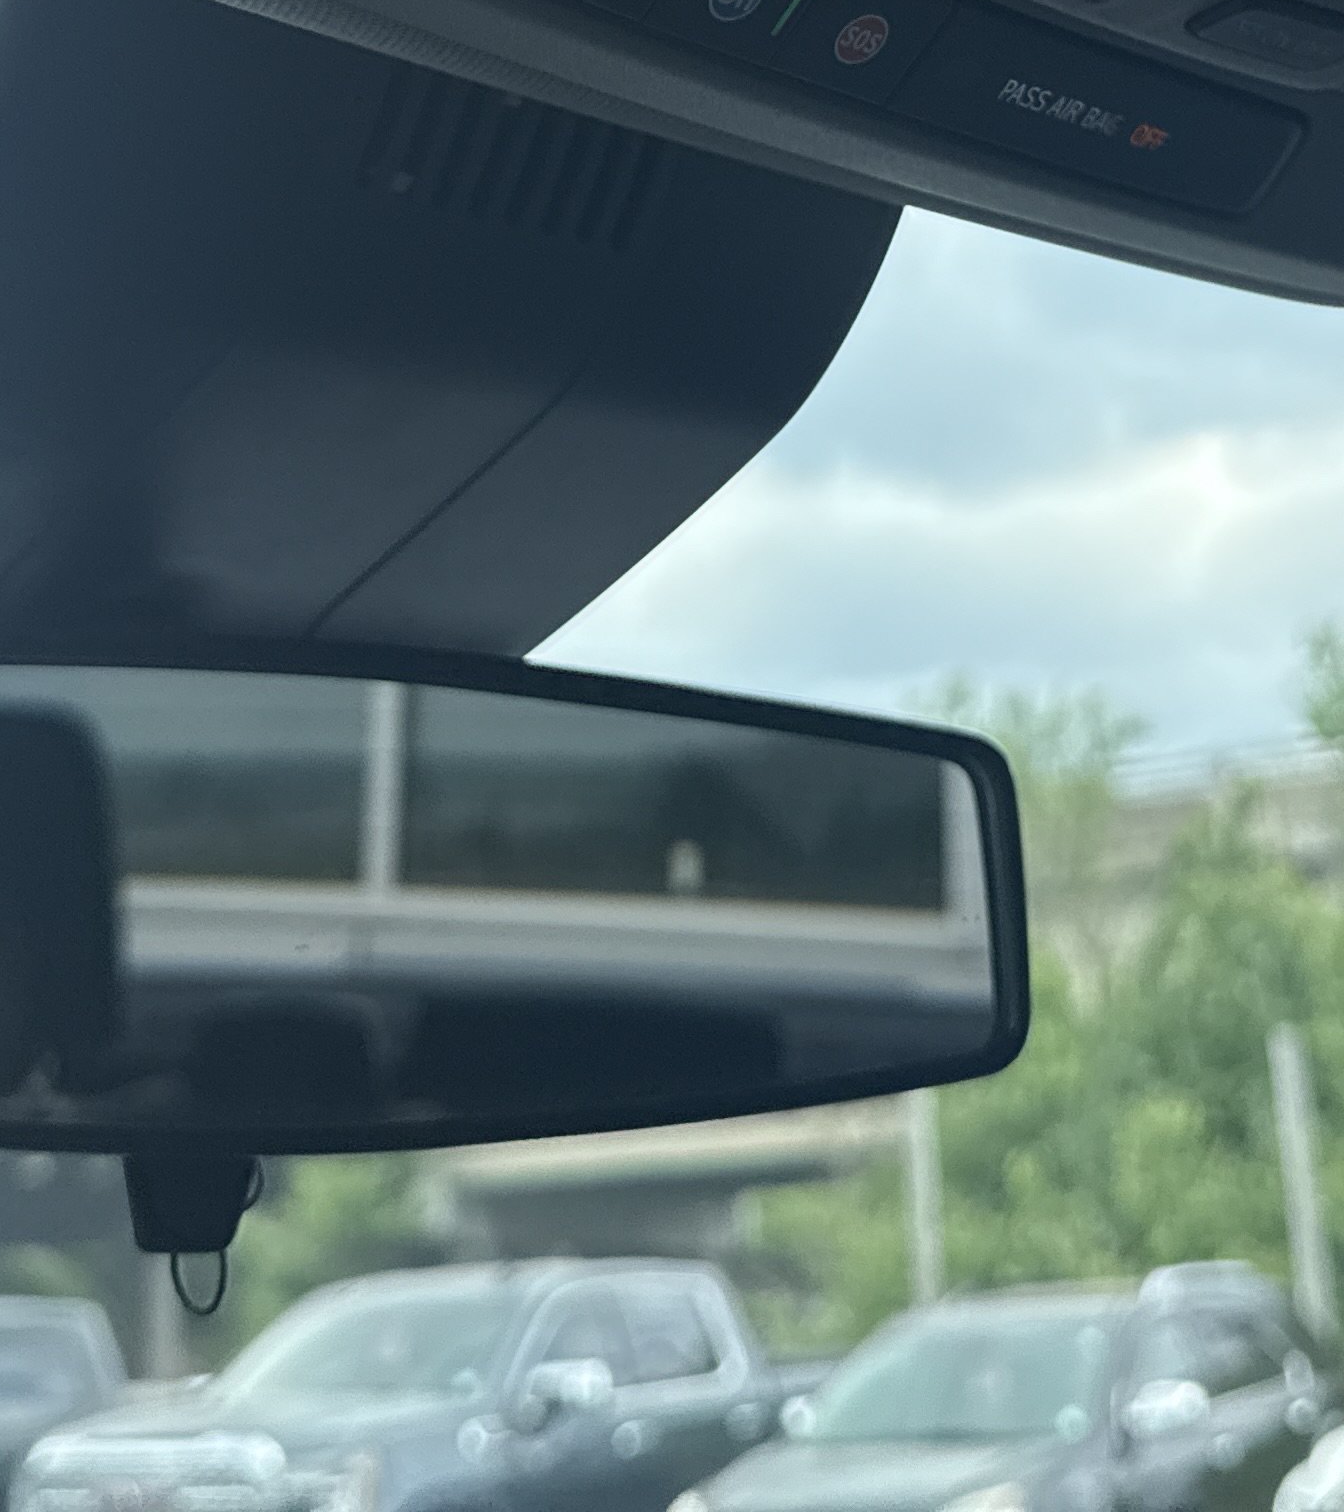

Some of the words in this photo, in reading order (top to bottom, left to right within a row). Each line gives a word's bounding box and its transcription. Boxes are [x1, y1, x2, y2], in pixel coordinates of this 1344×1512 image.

[839, 24, 883, 54] SOS
[997, 78, 1053, 113] PASS
[1046, 95, 1086, 124] AIR
[1080, 106, 1125, 136] BAG
[1129, 120, 1170, 151] OFF
